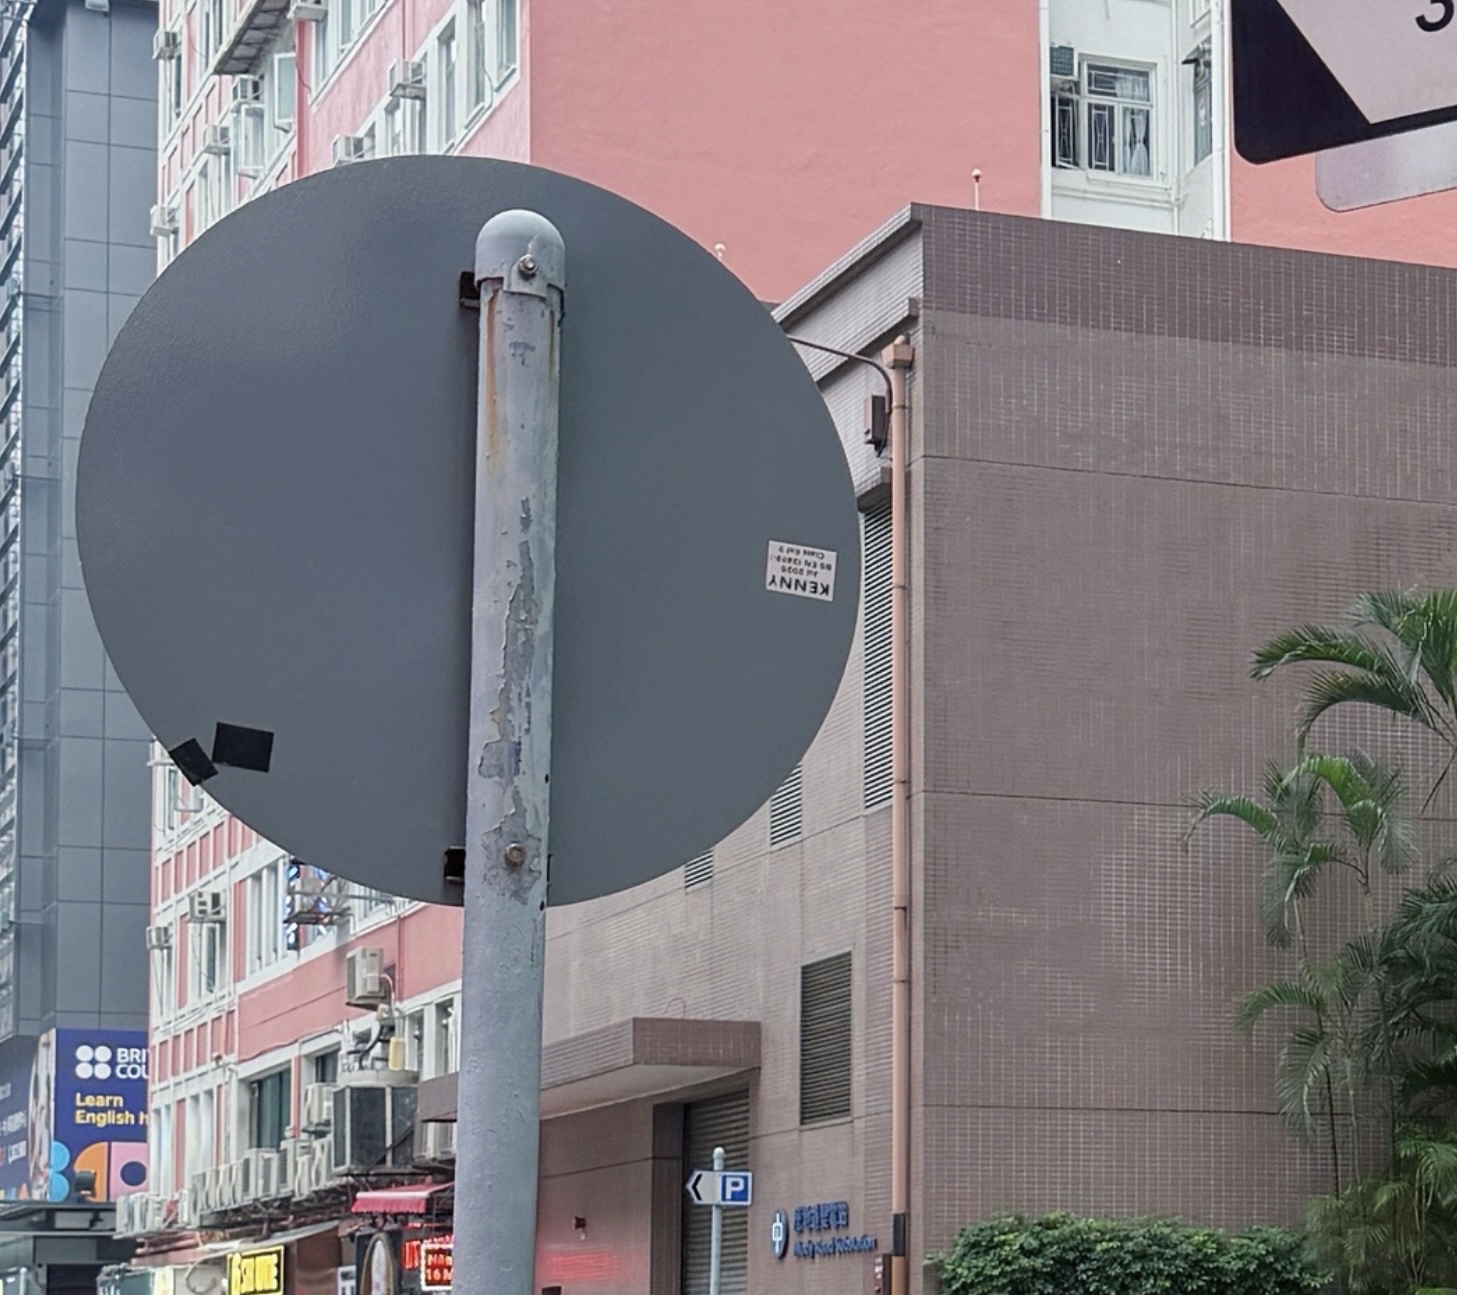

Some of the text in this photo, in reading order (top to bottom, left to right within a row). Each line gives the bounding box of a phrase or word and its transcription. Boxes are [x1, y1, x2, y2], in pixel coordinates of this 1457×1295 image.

[768, 574, 830, 596] KENNY
[76, 1092, 124, 1107] Learn
[75, 1110, 135, 1127] English
[725, 1177, 744, 1199] P
